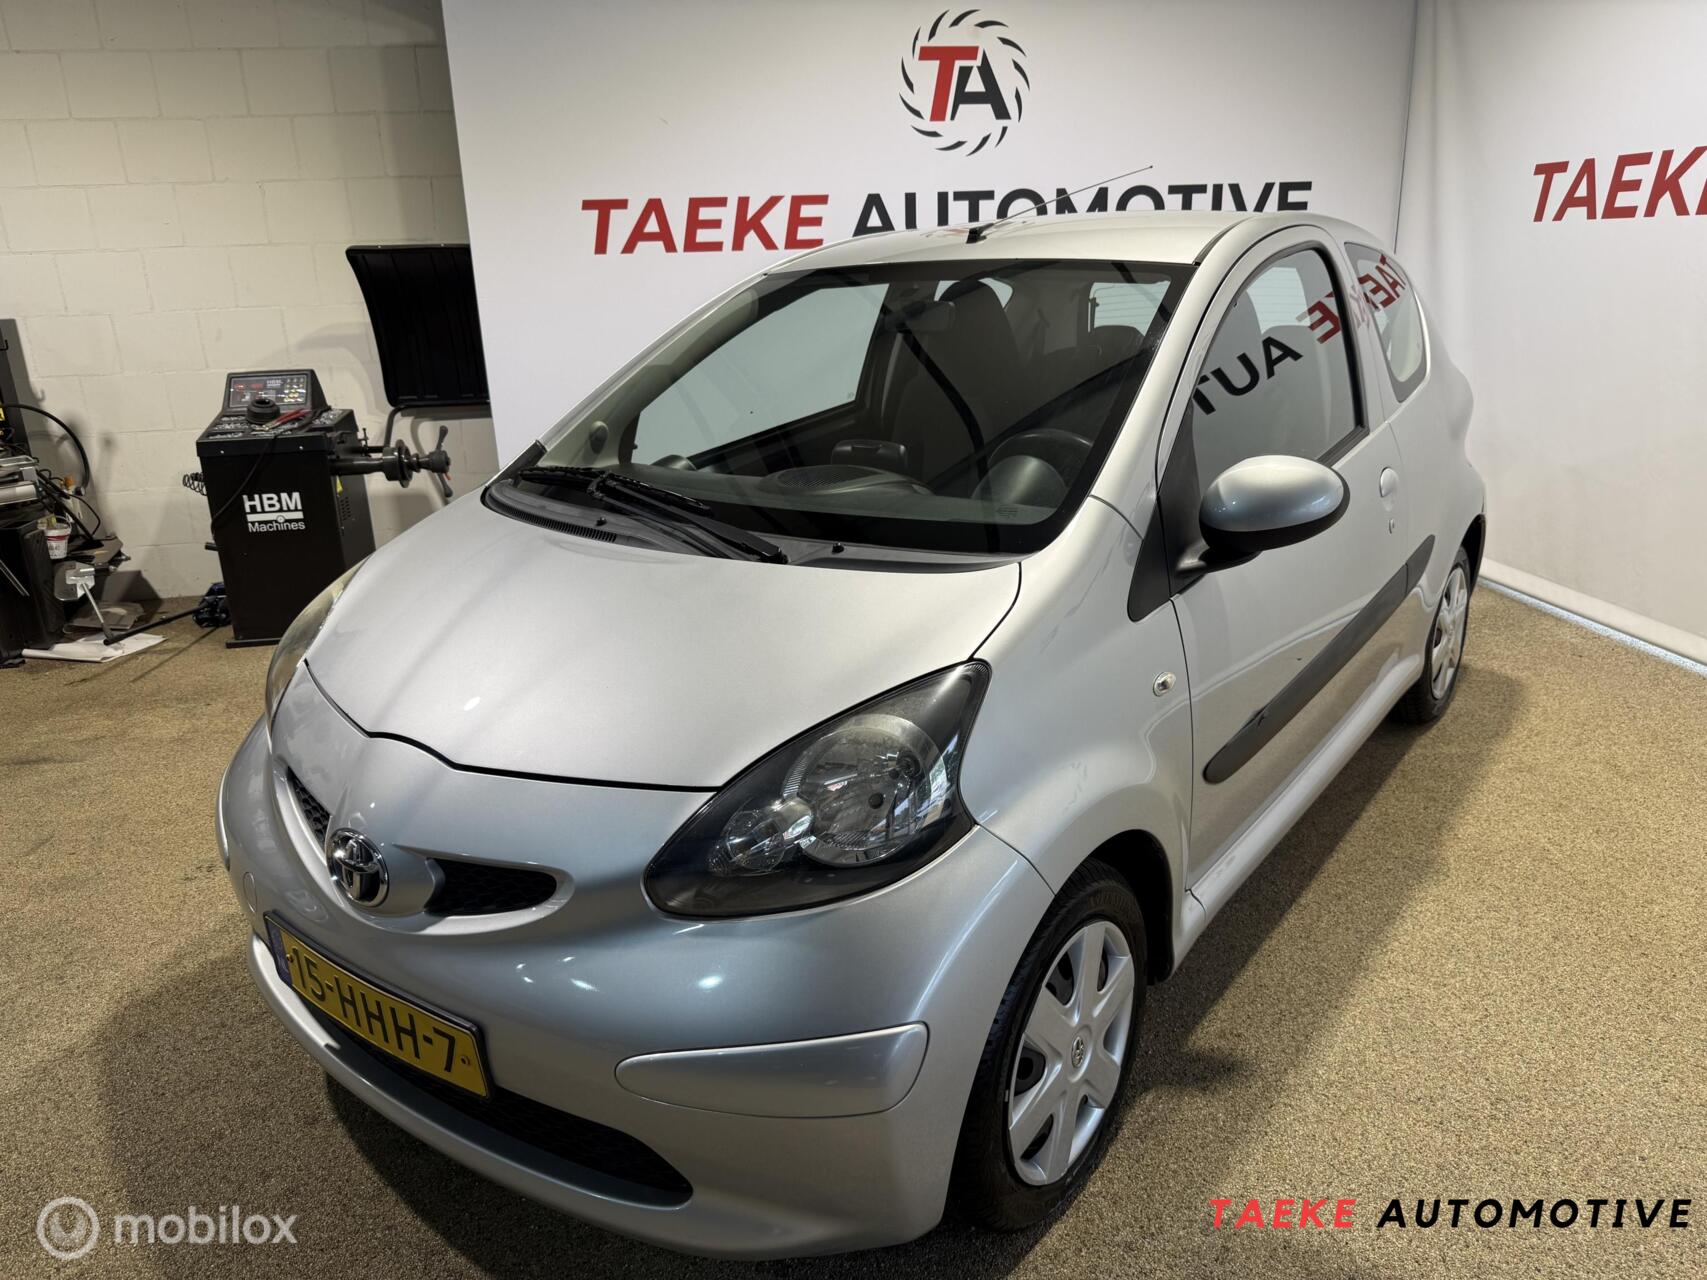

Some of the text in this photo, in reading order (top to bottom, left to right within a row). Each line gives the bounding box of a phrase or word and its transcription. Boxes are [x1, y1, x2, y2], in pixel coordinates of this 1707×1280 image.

[917, 45, 1012, 122] TA
[1534, 145, 1707, 222] TAEK
[582, 195, 829, 255] TAEKE
[242, 491, 303, 513] HBM
[247, 520, 306, 533] Machines
[292, 947, 456, 1073] 15-HHH-7
